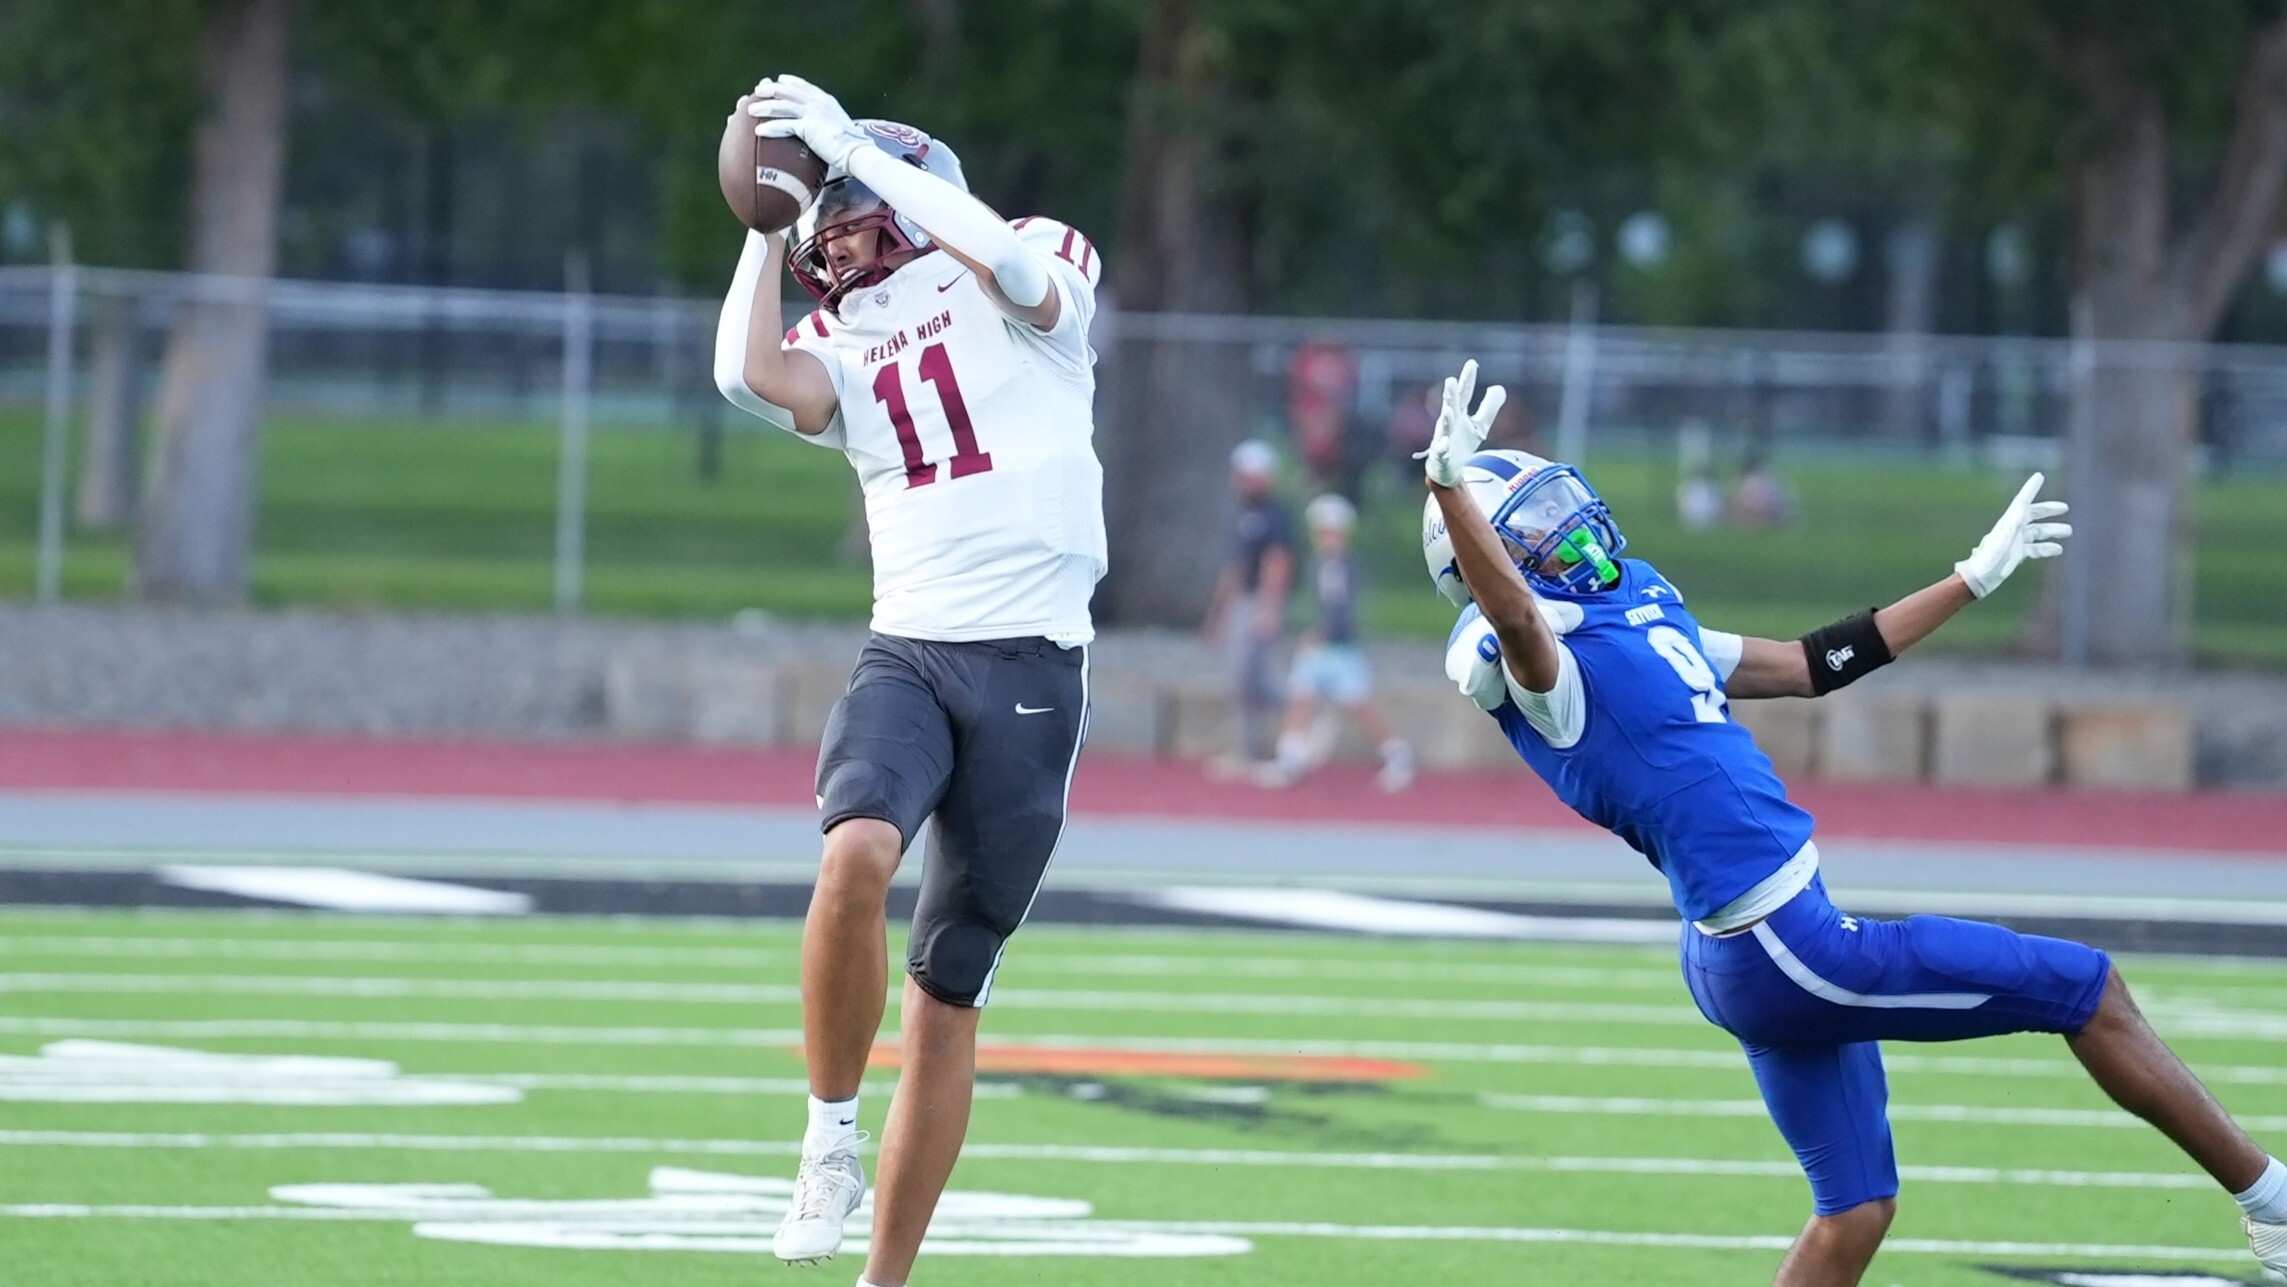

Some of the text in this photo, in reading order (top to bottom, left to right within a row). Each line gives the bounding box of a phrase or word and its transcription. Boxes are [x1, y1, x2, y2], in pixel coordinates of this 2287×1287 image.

[863, 310, 952, 367] HELENA HIGH
[872, 342, 993, 491] 11
